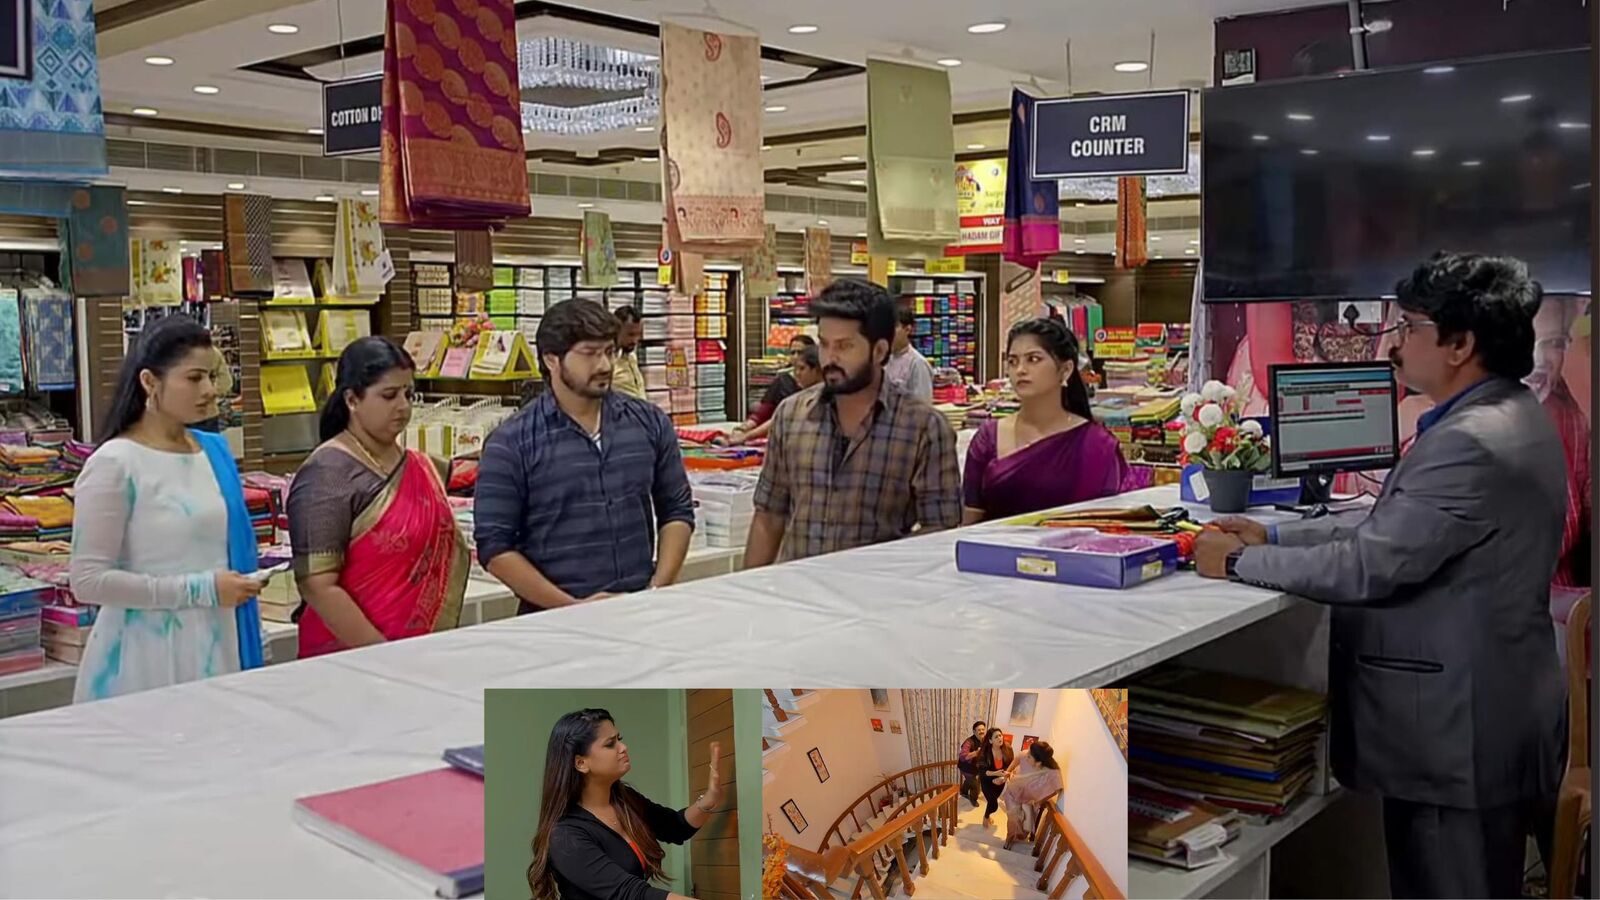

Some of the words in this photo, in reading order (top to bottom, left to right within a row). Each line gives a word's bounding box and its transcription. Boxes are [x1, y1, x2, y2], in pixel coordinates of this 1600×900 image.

[331, 108, 369, 127] COTTON
[1089, 115, 1126, 133] CRM
[1071, 137, 1145, 157] COUNTER
[982, 217, 1000, 225] WAY
